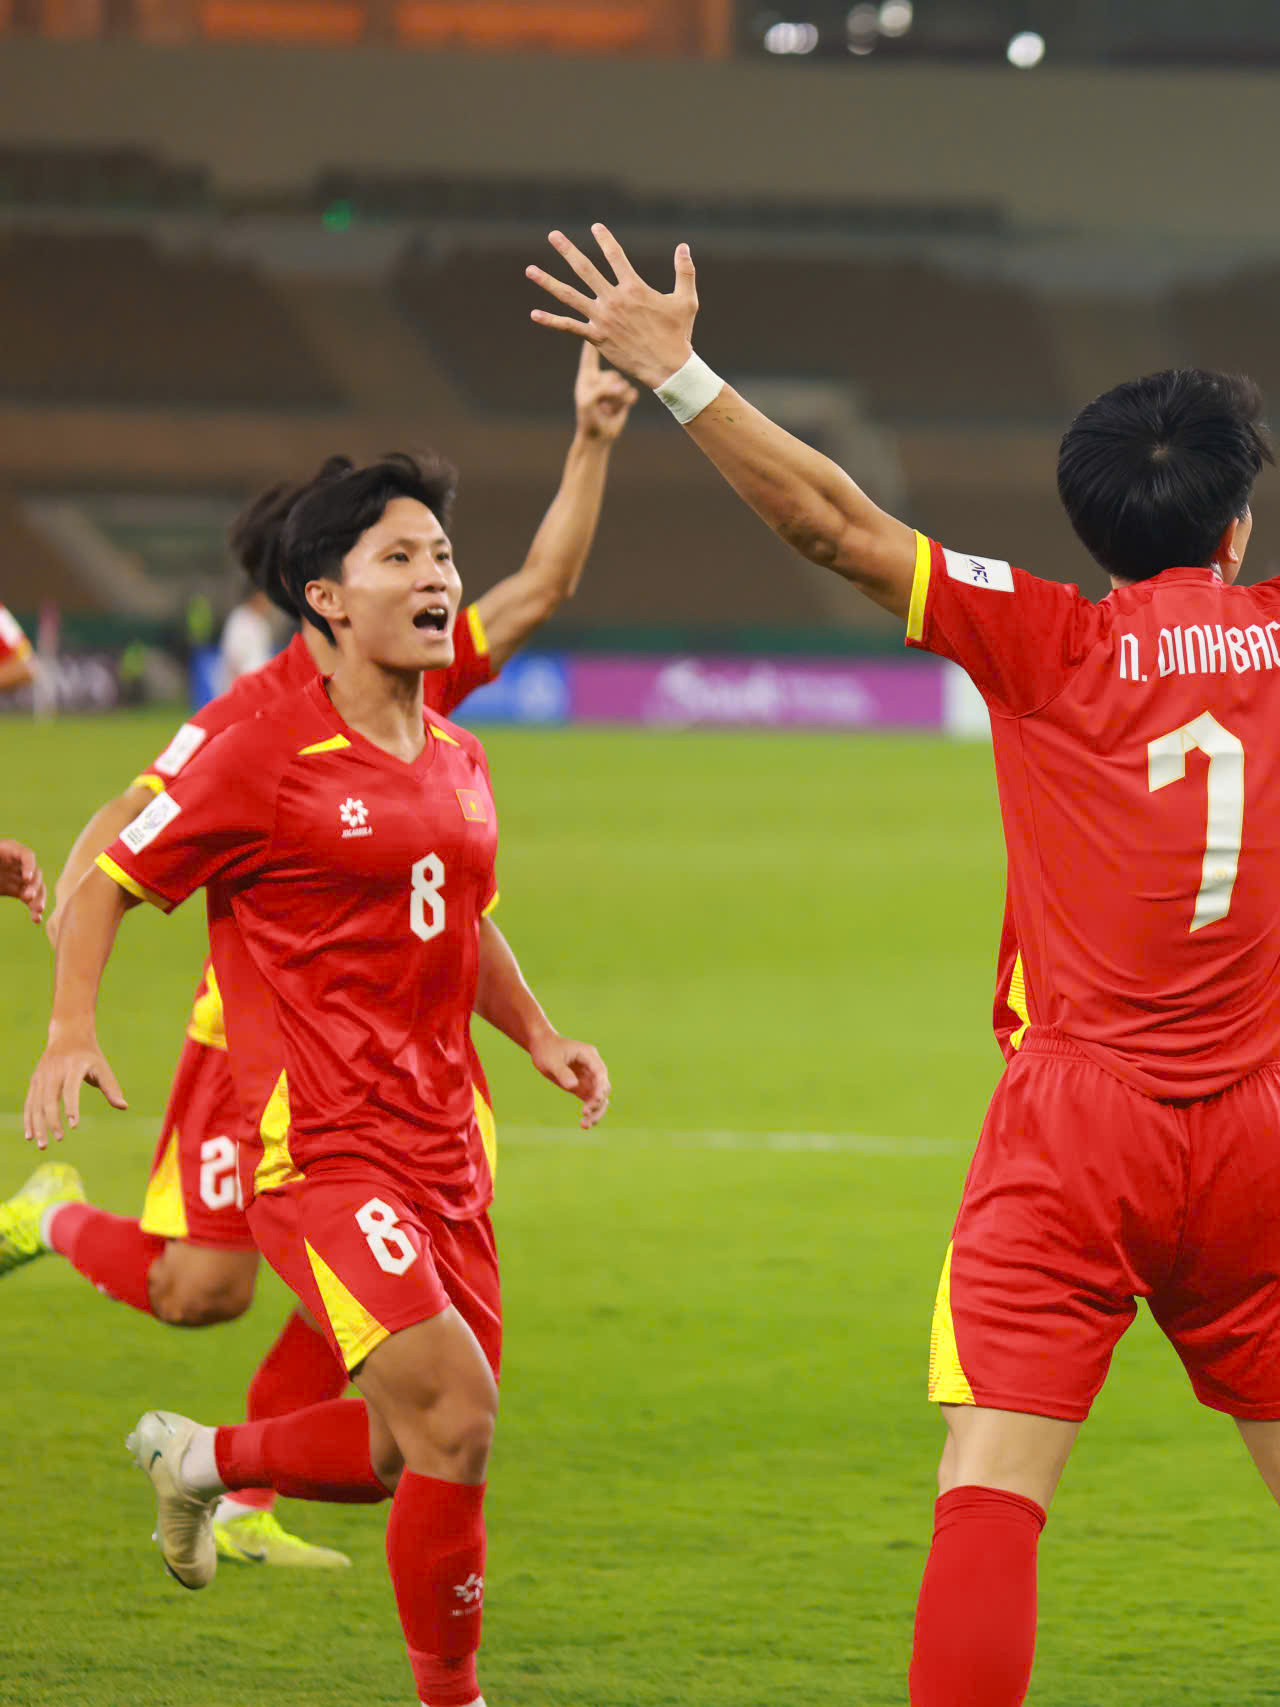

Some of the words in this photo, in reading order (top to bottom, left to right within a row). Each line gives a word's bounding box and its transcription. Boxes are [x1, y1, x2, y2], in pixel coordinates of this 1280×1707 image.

[969, 559, 989, 584] AFC
[1147, 711, 1244, 933] 7
[410, 852, 445, 943] 8
[355, 1197, 417, 1276] 8
